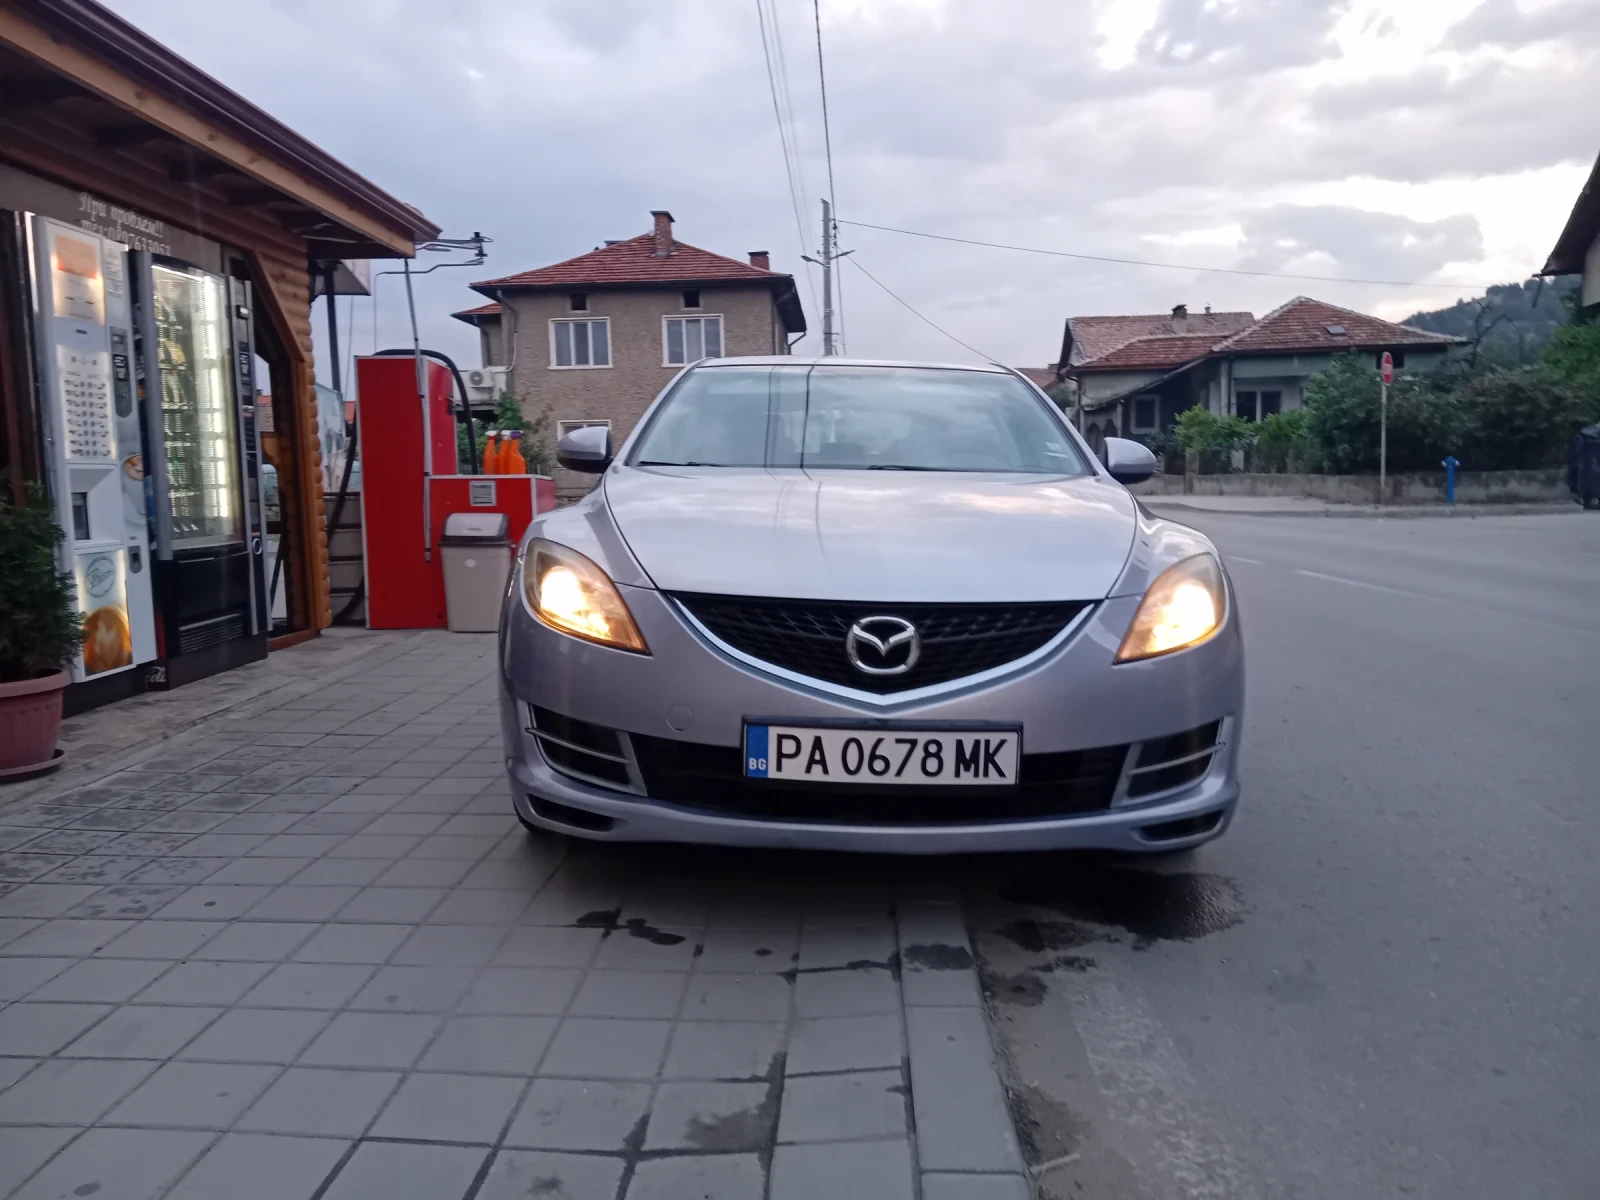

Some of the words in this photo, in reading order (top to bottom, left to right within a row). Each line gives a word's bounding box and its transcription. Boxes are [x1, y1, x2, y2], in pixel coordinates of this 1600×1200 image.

[748, 757, 767, 771] BG
[776, 733, 830, 776] PA
[841, 737, 944, 778] 0678
[954, 738, 1008, 779] MK
